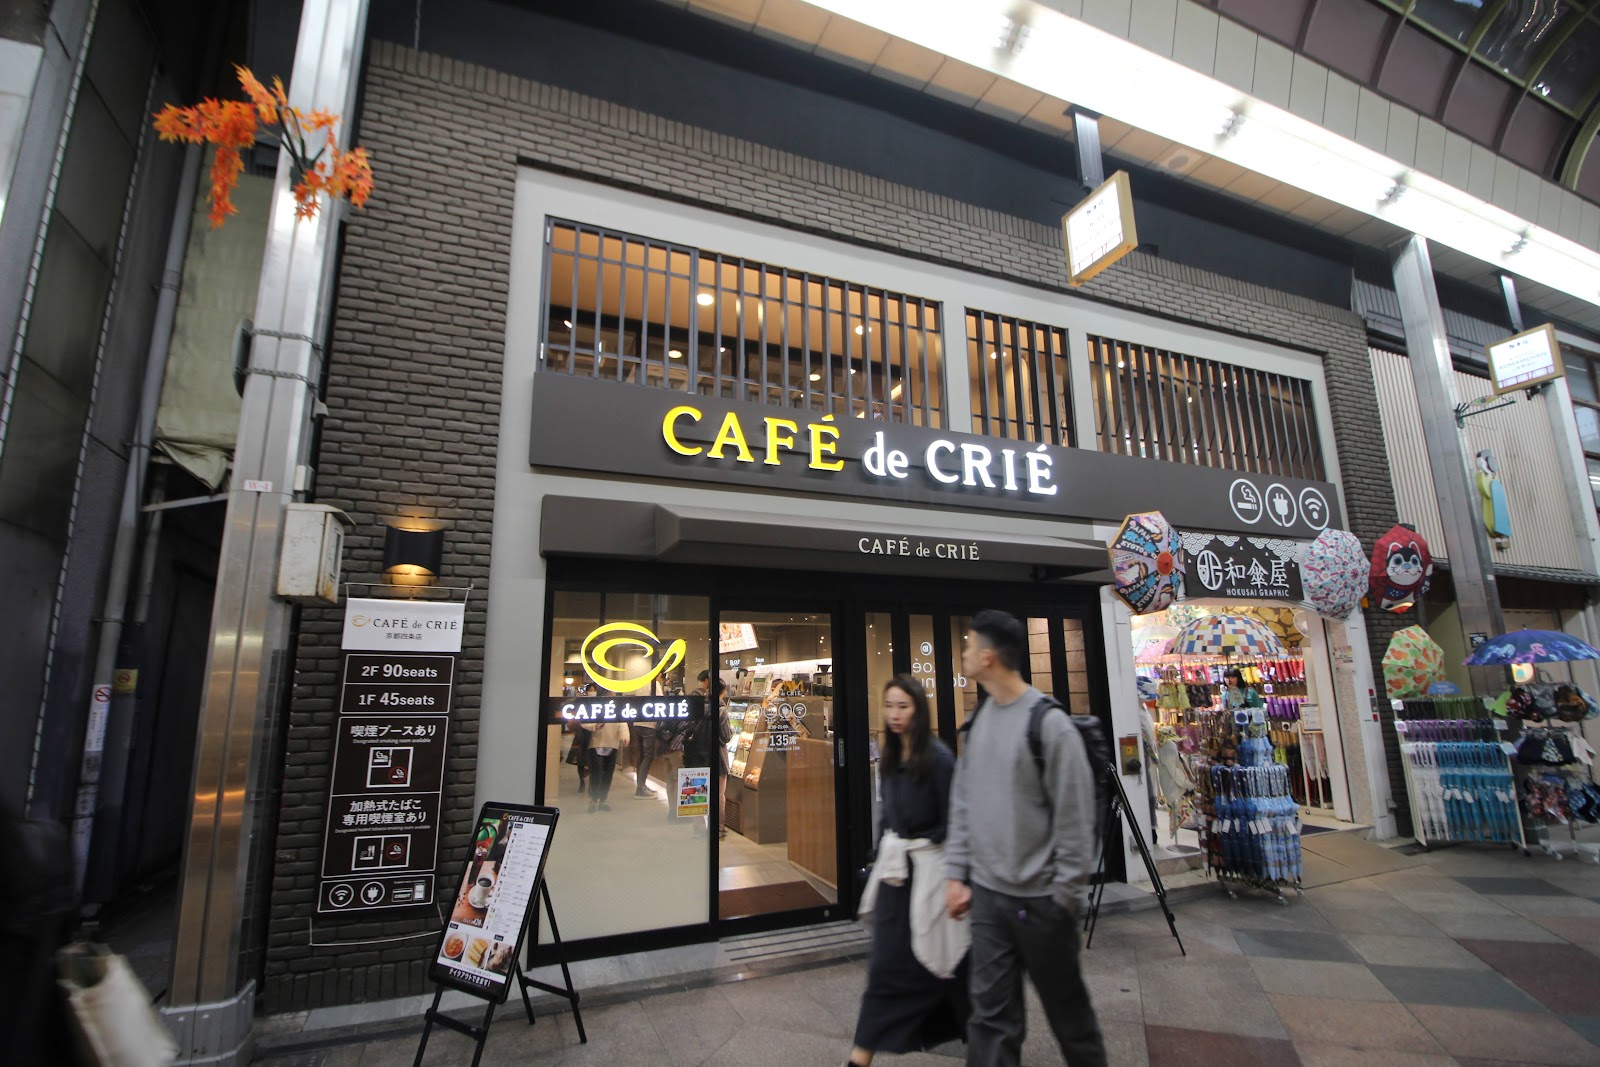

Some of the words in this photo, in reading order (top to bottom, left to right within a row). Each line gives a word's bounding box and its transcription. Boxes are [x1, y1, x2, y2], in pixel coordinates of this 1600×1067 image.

[662, 405, 845, 472] CAFÉ
[863, 431, 908, 478] de
[925, 440, 1058, 496] CRIÉ
[858, 537, 910, 557] CAFÉ
[916, 542, 930, 558] de
[935, 542, 980, 561] CRIÉ
[1121, 540, 1144, 553] KYOTO
[1224, 557, 1290, 589] 和傘屋
[1226, 588, 1257, 596] HOKUSAI
[1259, 589, 1290, 597] GRAPHIC
[373, 617, 409, 628] CAFÉ
[412, 620, 422, 629] de
[426, 619, 457, 630] CRIÉ
[385, 632, 423, 640] 京都四条店
[361, 665, 379, 677] 2F
[383, 664, 438, 678] 90seats
[358, 694, 376, 706] 1F
[380, 692, 435, 706] 45seats
[561, 700, 617, 720] CAFÉ
[621, 704, 637, 718] de
[642, 699, 689, 718] CRIÉ
[350, 724, 437, 738] 喫煙ブースあり
[350, 798, 422, 813] 加熱式たばこ
[342, 812, 427, 826] 専用喫煙室あり
